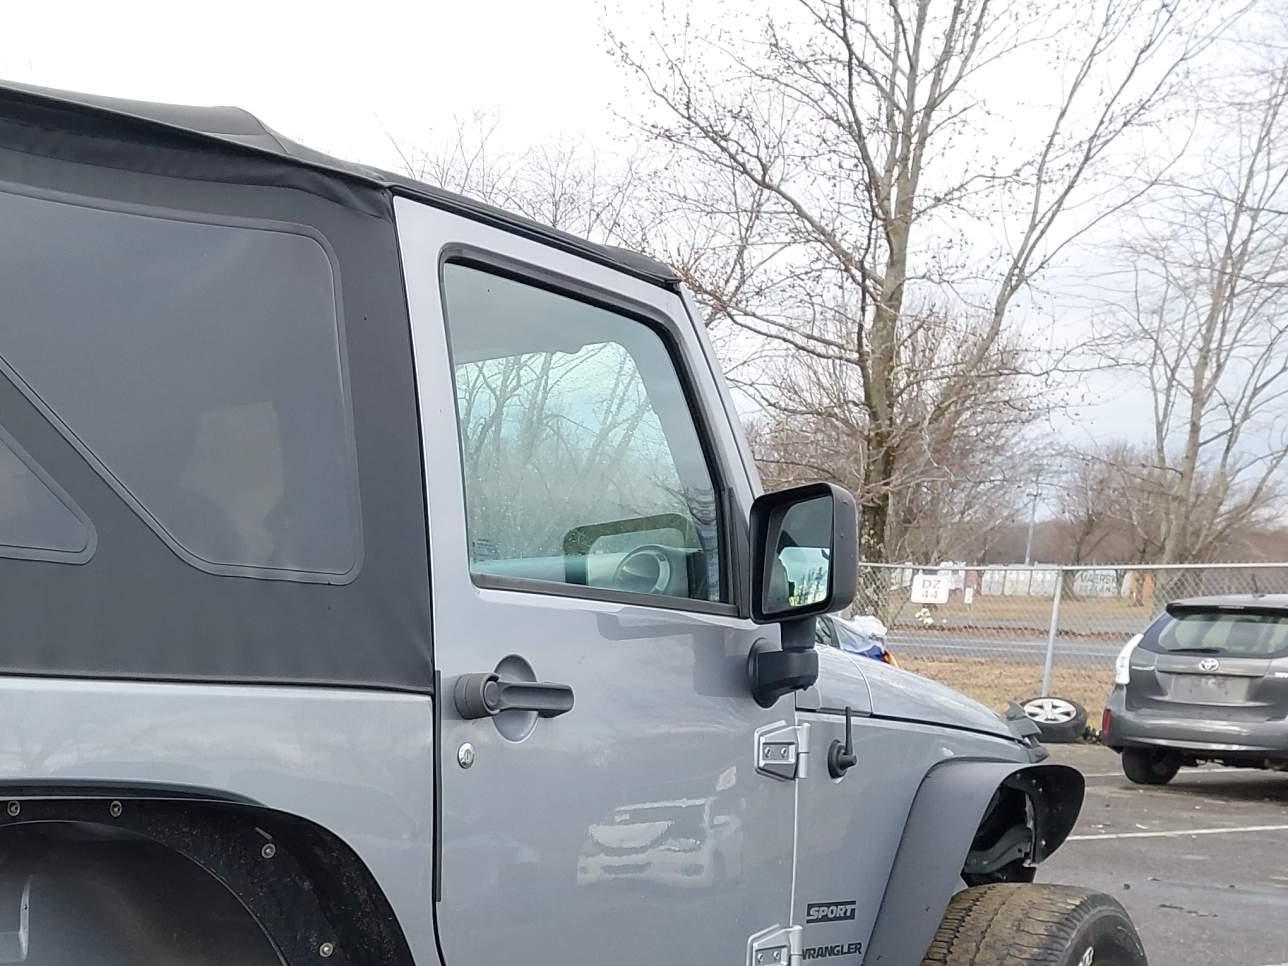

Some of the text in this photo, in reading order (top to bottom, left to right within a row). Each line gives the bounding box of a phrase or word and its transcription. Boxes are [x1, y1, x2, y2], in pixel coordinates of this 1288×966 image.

[922, 579, 942, 589] DZ
[922, 590, 938, 599] 44
[807, 904, 856, 920] SPORT
